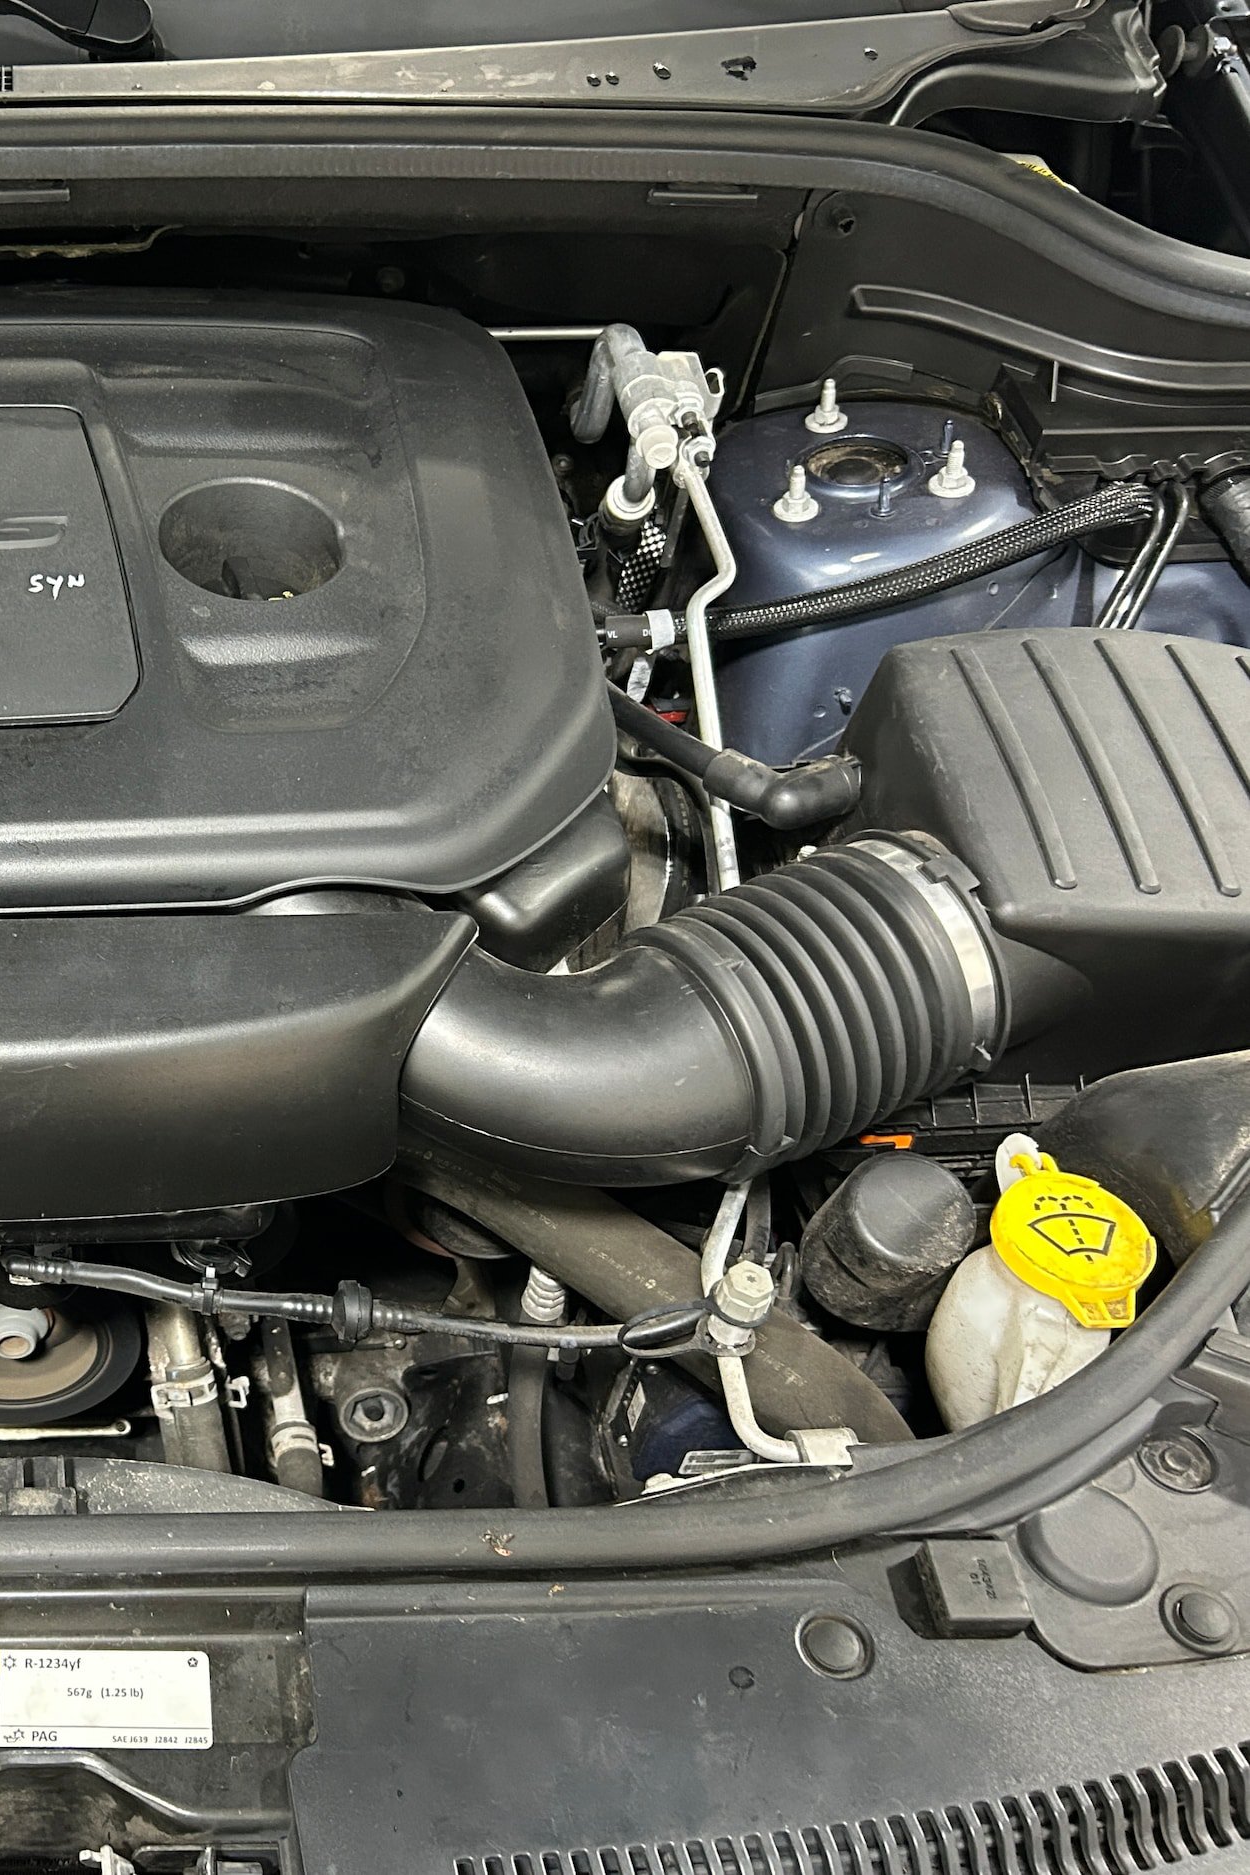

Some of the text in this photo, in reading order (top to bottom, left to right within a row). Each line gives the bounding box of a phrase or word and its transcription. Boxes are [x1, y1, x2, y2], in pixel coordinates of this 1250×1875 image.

[25, 1658, 81, 1671] R-1234yf
[67, 1687, 144, 1699] 567g (1.25 lb)
[32, 1731, 58, 1742] PAG
[112, 1735, 208, 1745] SAE J639 J2842 J2845
